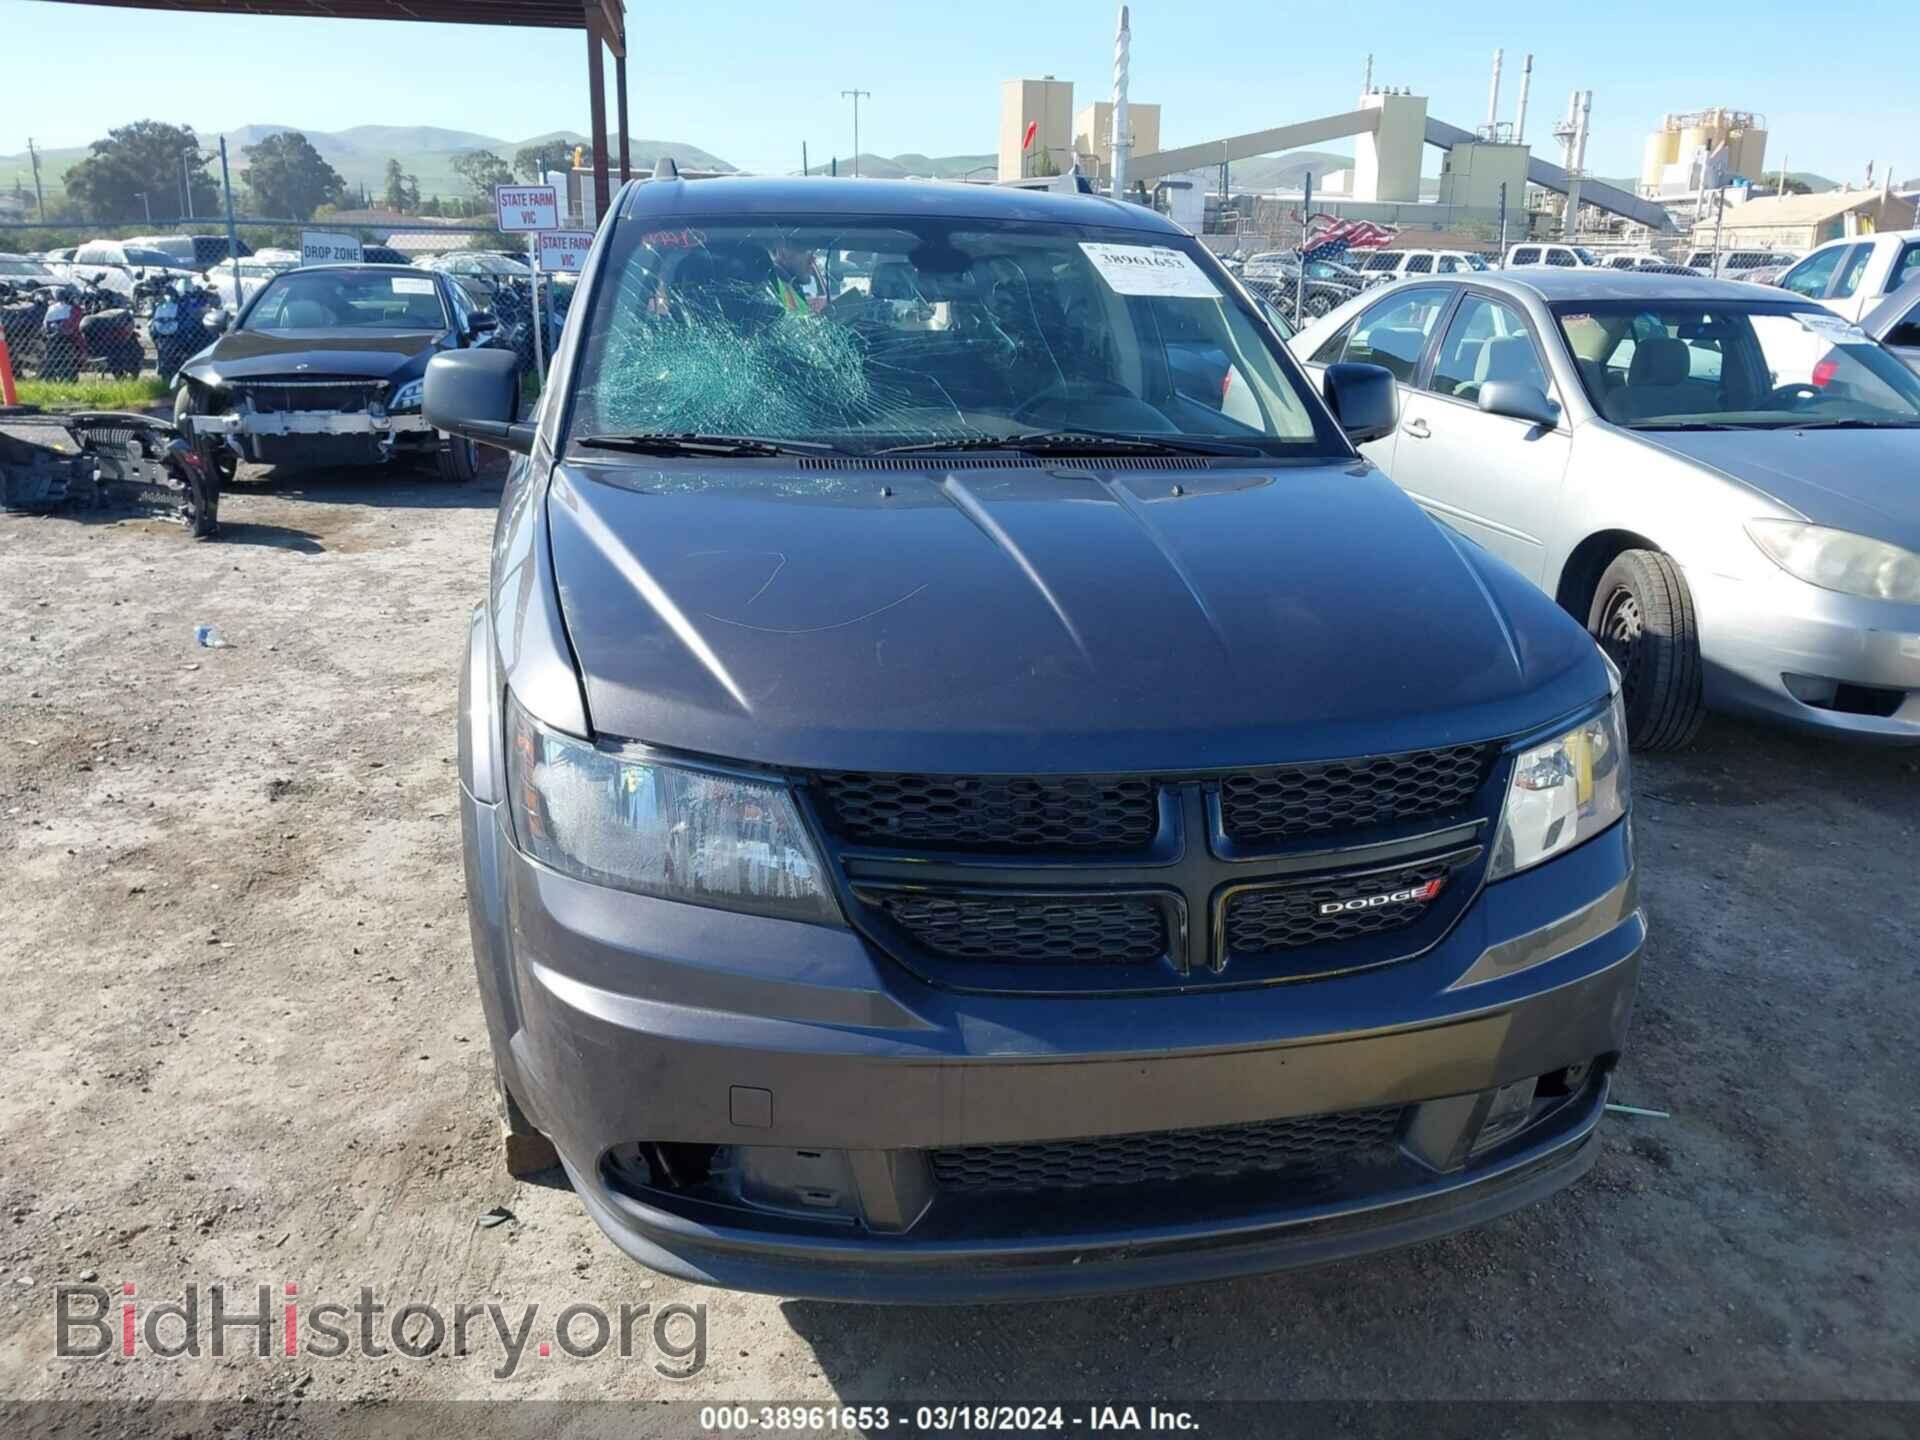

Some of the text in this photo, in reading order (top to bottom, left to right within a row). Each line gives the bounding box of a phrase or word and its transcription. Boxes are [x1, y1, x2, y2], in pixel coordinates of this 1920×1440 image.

[501, 193, 553, 207] STATE FARM
[521, 211, 536, 224] VIC
[542, 237, 593, 250] STATE FARM
[304, 245, 359, 260] DROP ZONE
[561, 254, 575, 267] VIC
[1101, 253, 1185, 270] 38961653
[1320, 885, 1428, 915] DODGE
